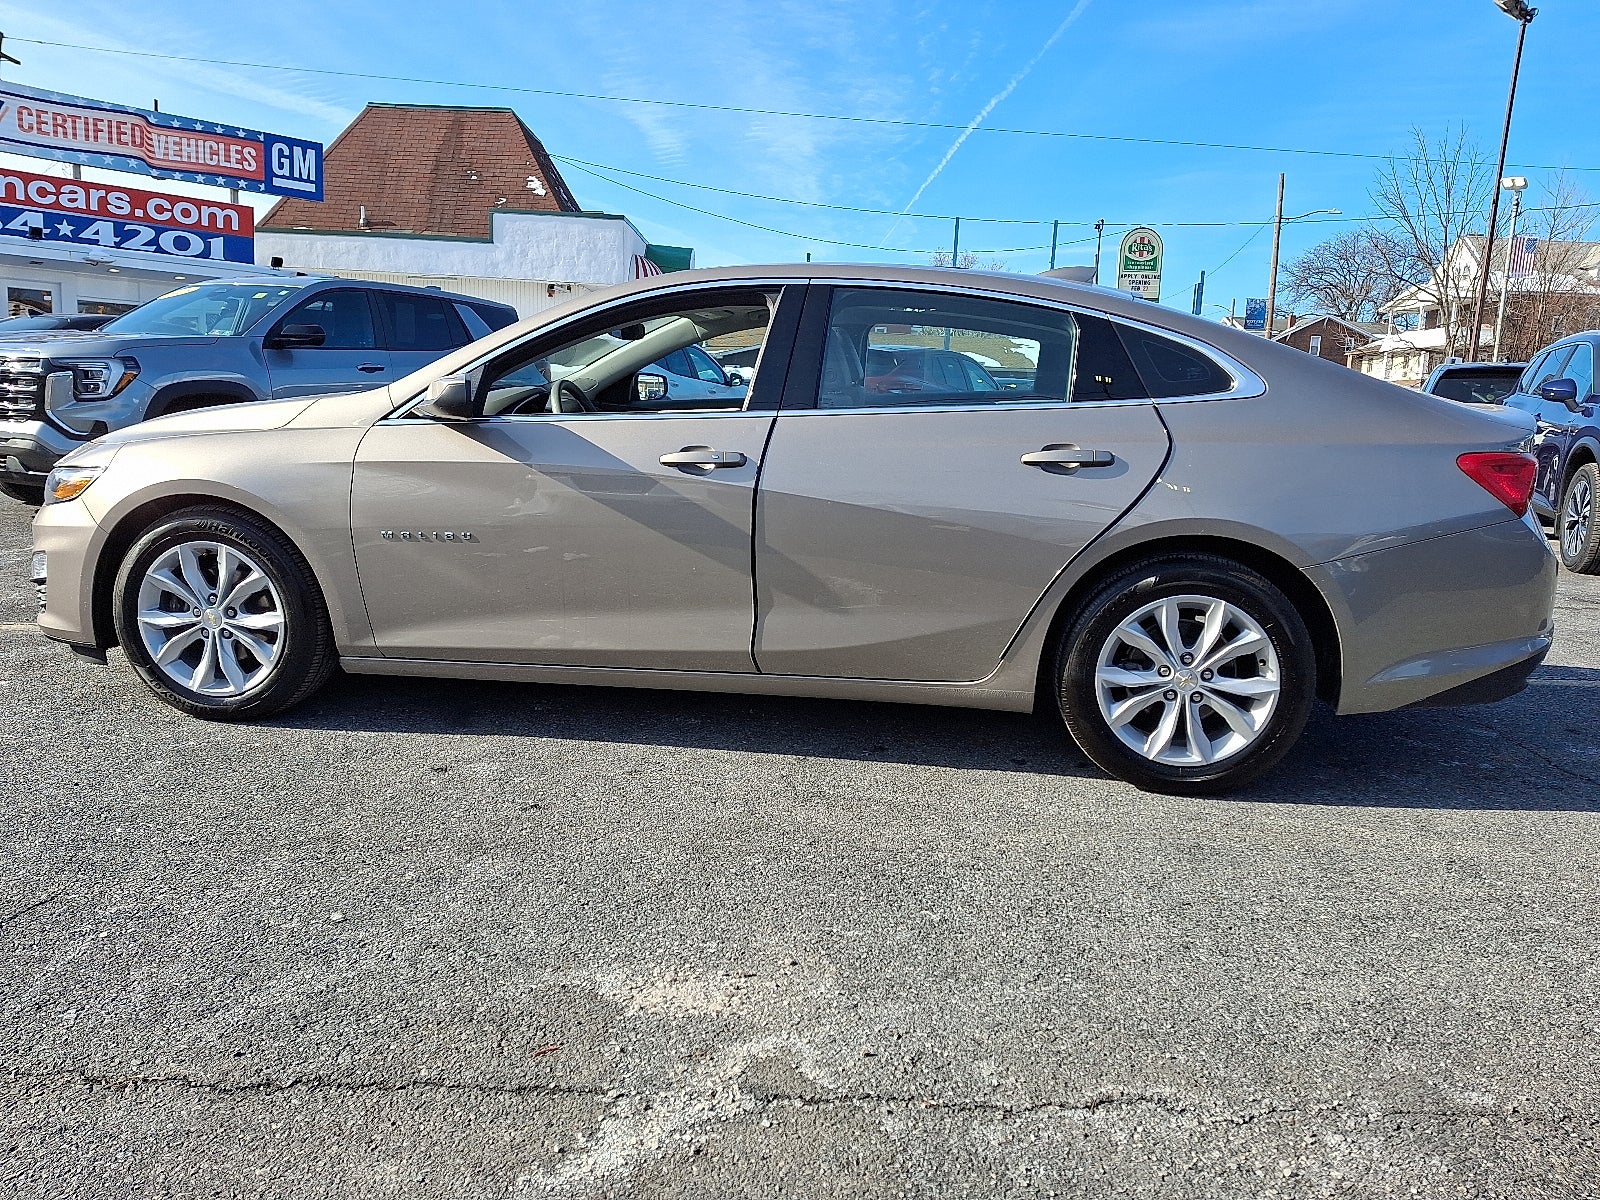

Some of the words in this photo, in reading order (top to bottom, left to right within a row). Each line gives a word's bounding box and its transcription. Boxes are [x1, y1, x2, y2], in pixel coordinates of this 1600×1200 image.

[16, 105, 146, 149] CERTIFIED
[151, 131, 257, 173] VEHICLES
[271, 142, 317, 181] GM
[1131, 242, 1153, 252] Rita's
[380, 529, 472, 541] MALIBU
